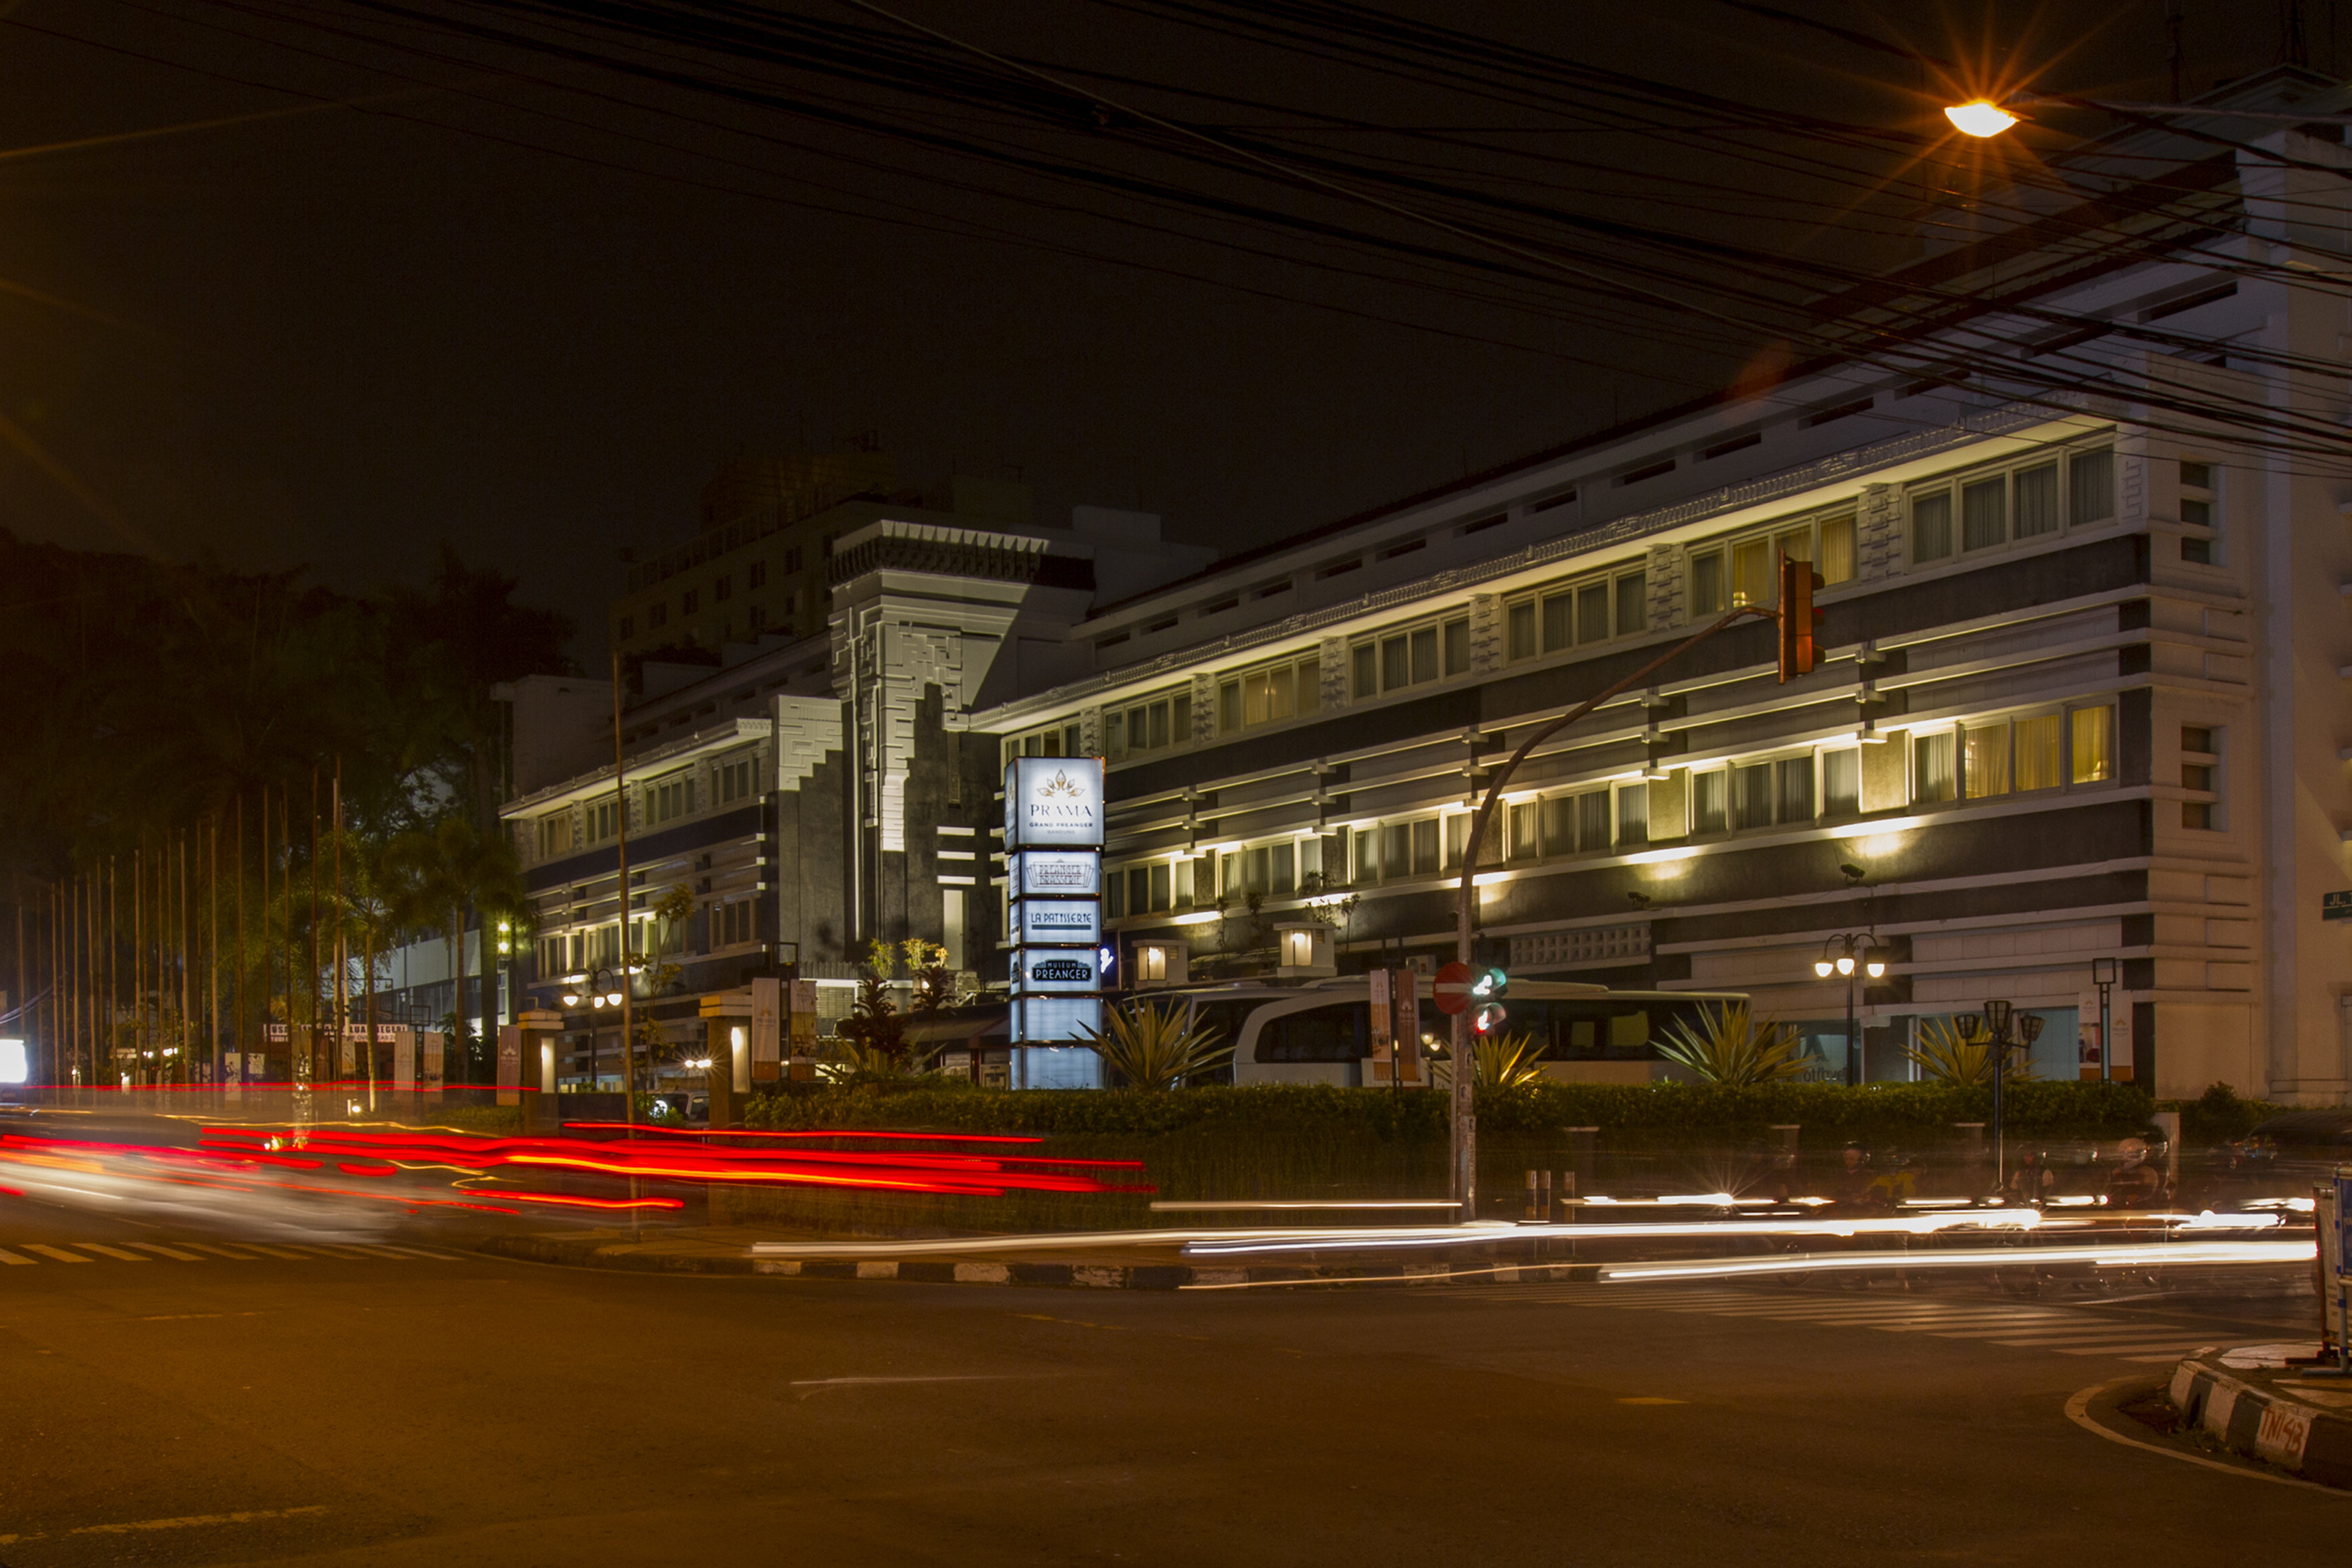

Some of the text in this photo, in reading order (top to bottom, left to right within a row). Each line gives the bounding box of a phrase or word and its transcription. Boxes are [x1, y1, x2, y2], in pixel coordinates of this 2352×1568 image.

[1030, 804, 1093, 817] PRAMA
[1040, 865, 1081, 875] PREANGER
[1040, 876, 1081, 886] BRASSERIE
[2329, 894, 2347, 905] JL.
[1031, 913, 1092, 923] LA PATISSERIE
[1036, 969, 1089, 980] PREANGER
